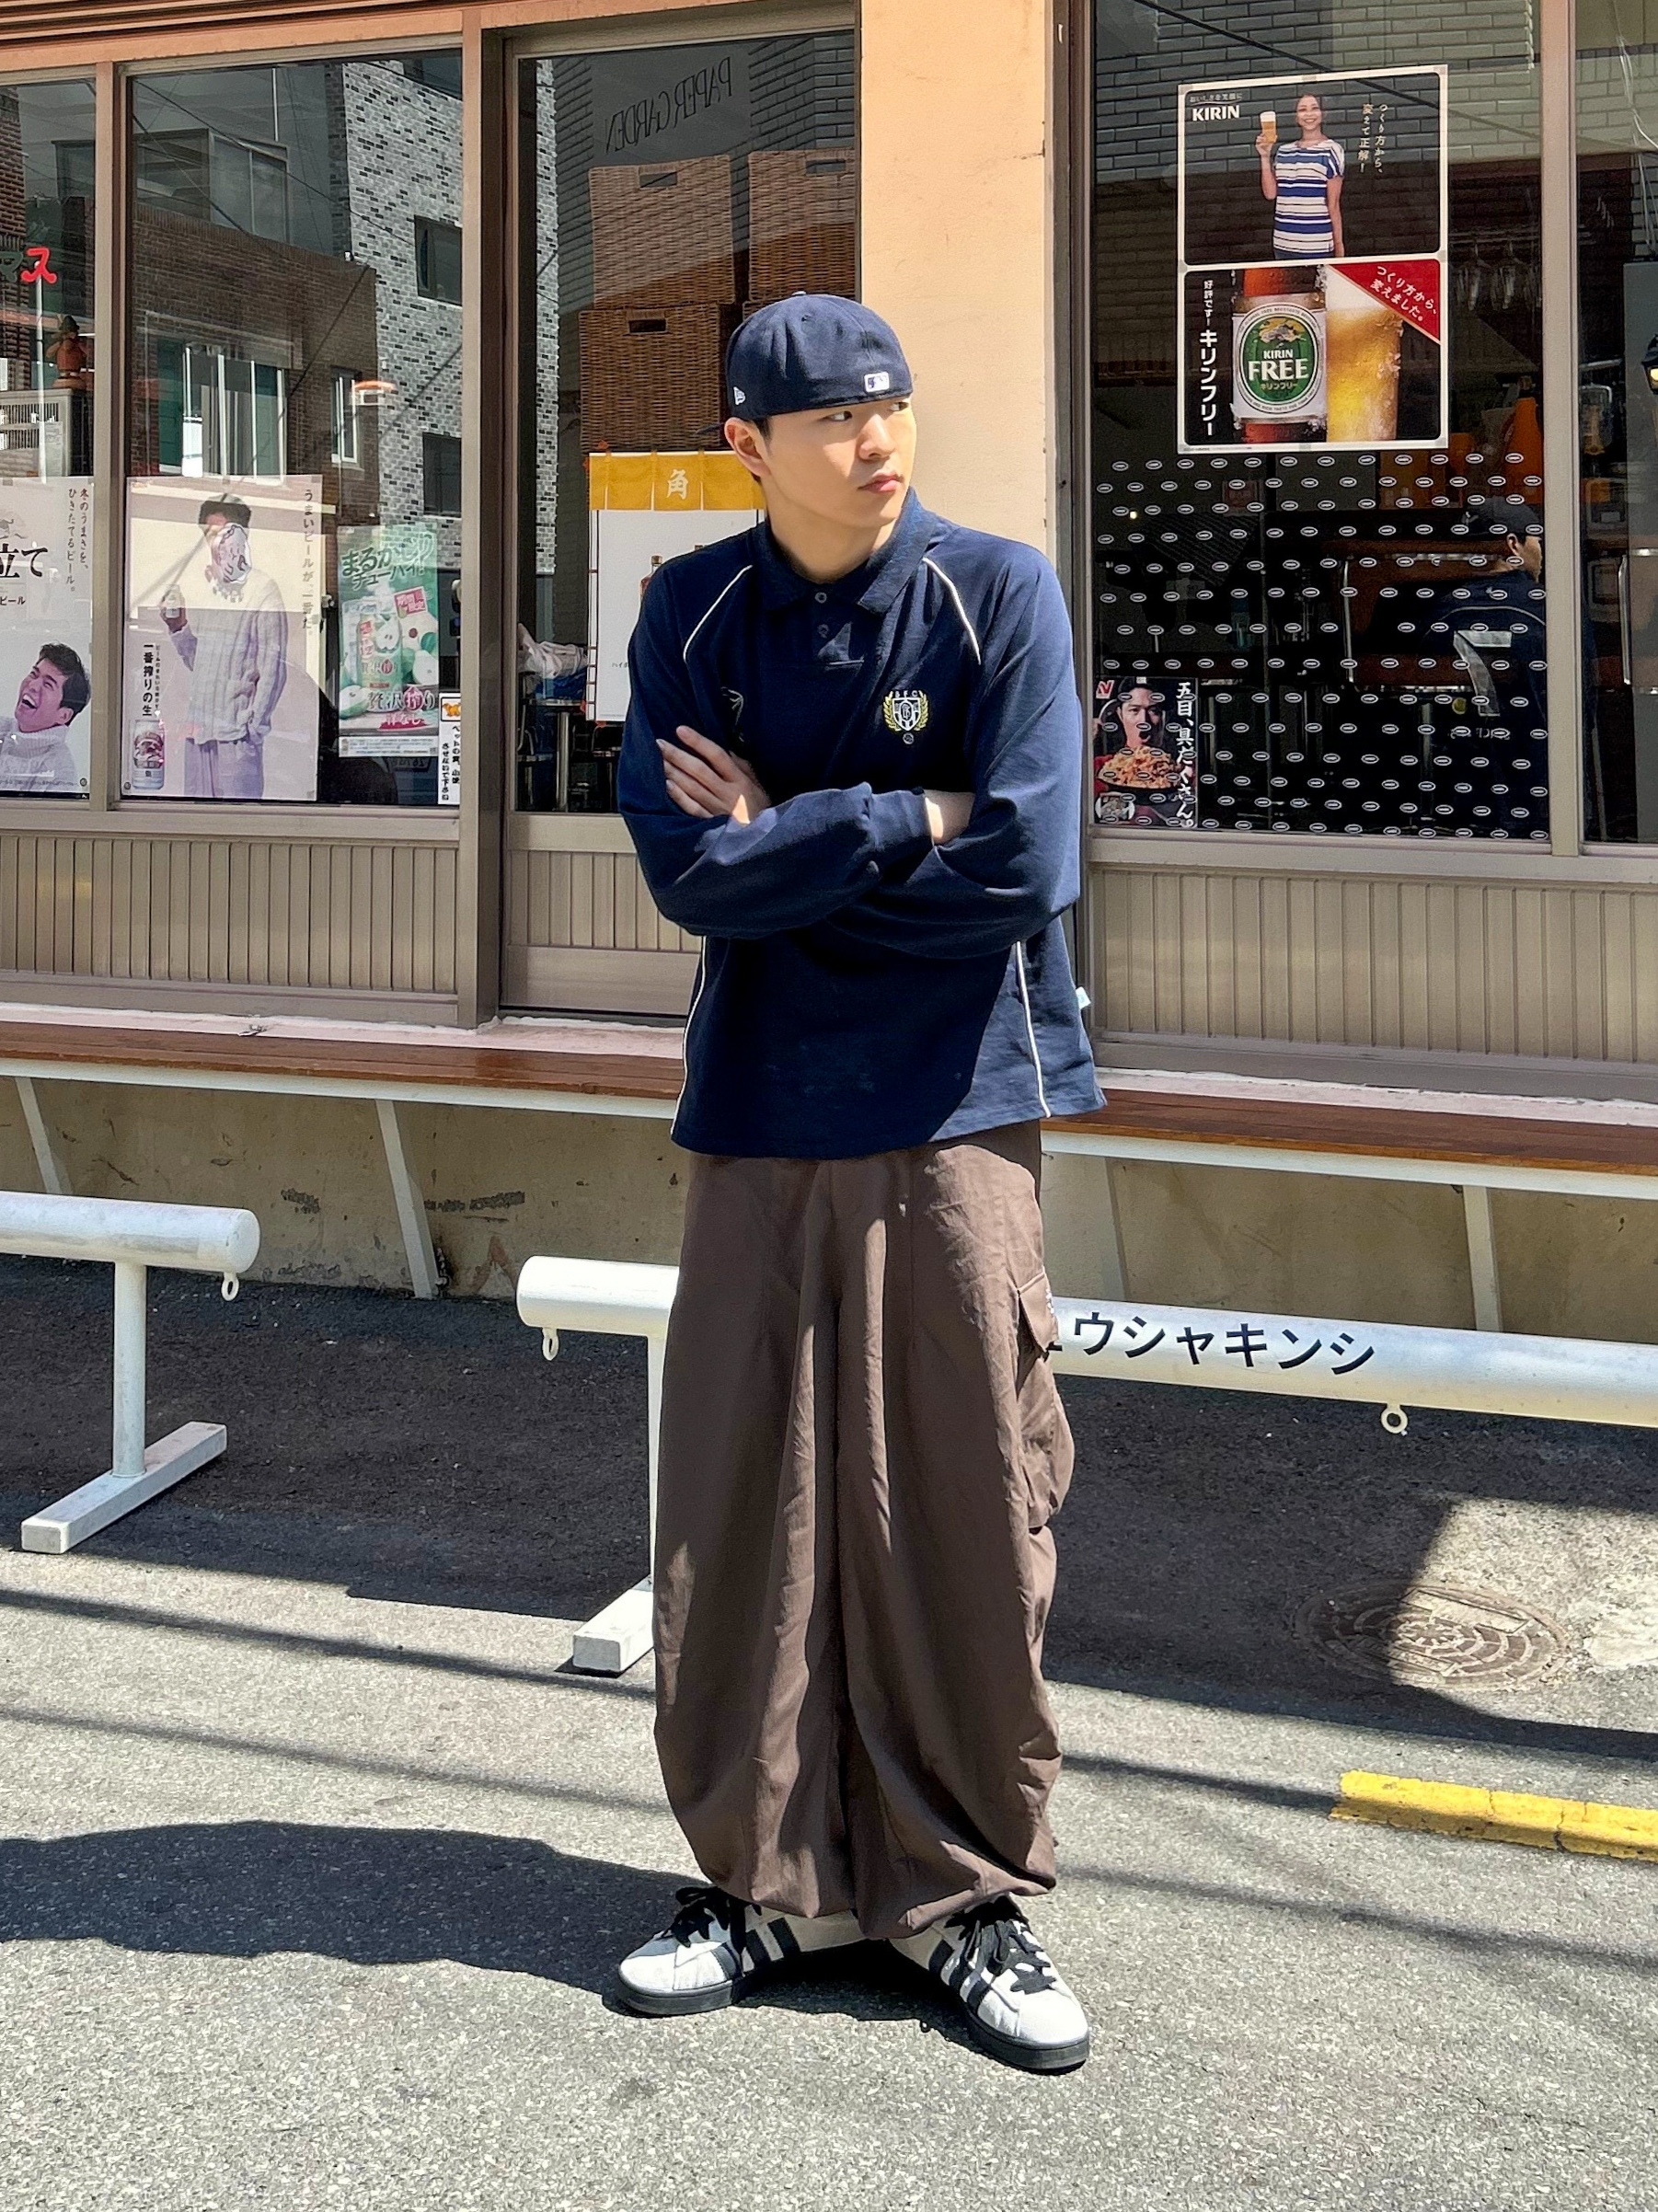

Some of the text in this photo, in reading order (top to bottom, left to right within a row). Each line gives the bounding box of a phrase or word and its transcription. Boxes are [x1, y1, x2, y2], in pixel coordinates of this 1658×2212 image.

[1192, 104, 1240, 121] KIRIN
[1374, 103, 1388, 174] つくり方から、
[1369, 278, 1423, 322] 変えました。
[1376, 265, 1437, 315] つくり方から、
[1248, 358, 1310, 382] FREE
[1263, 349, 1294, 360] KIRIN
[1199, 328, 1218, 436] キリンフリー
[1260, 381, 1299, 391] キリンフリー
[666, 468, 689, 500] 角
[142, 644, 155, 717] 一番搾りの生
[1045, 1311, 1375, 1376] ウシャキンシ
